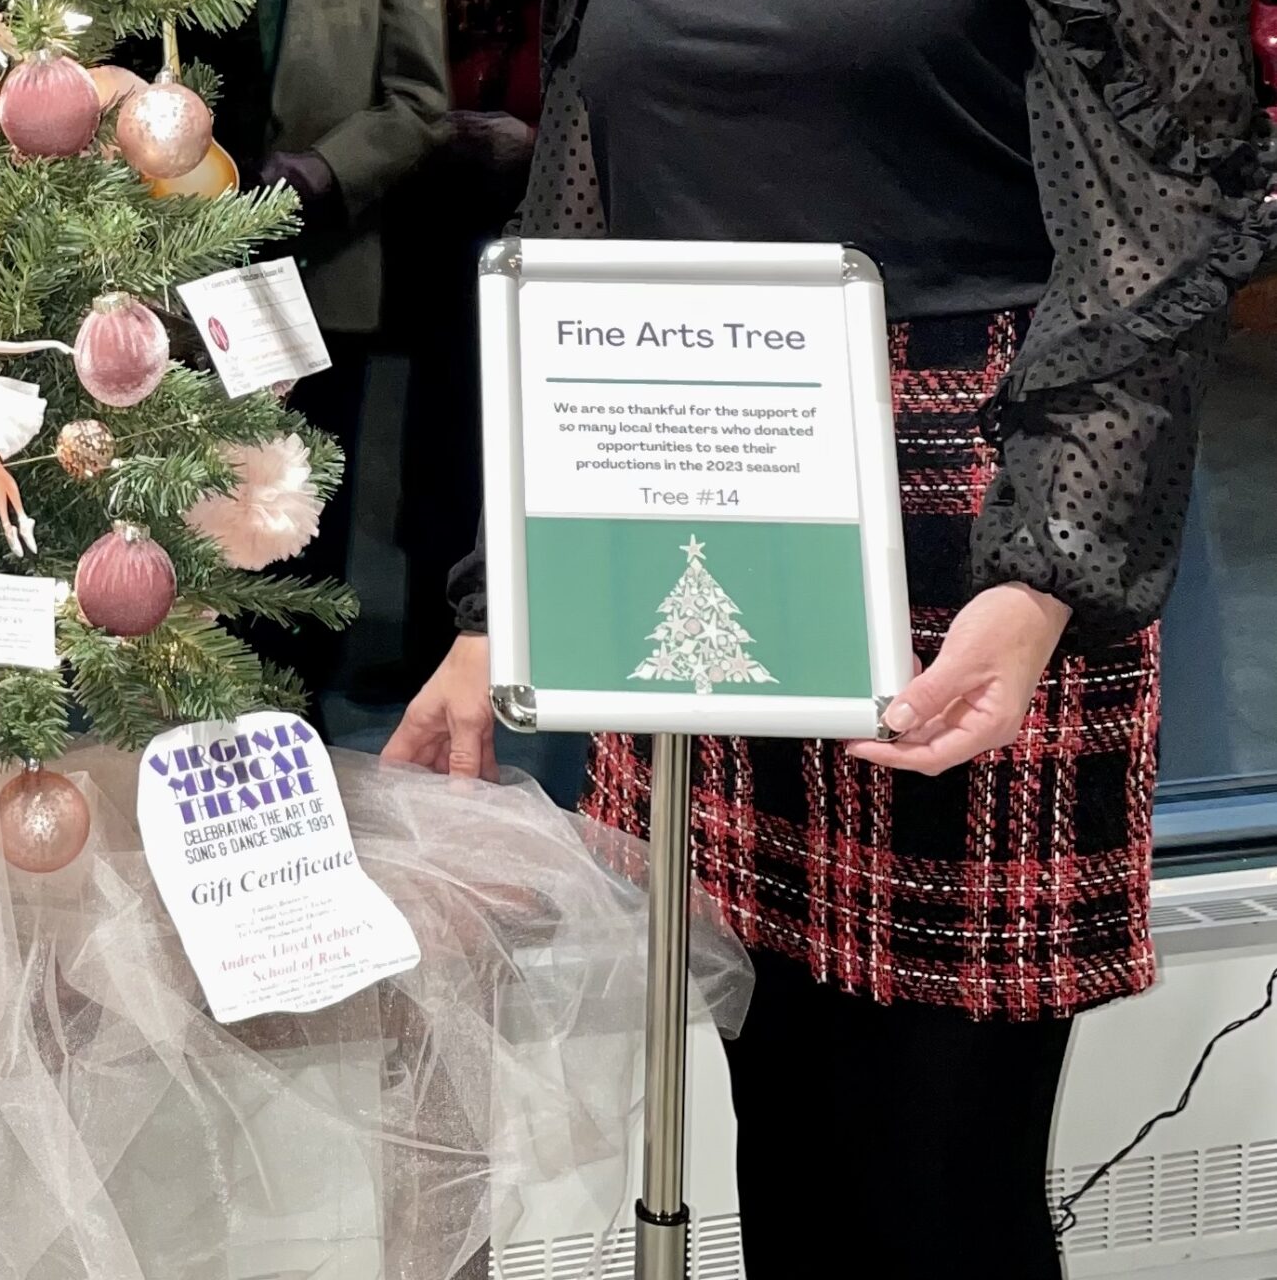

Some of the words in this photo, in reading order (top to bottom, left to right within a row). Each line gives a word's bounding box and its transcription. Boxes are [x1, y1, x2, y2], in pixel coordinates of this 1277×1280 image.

[557, 320, 625, 347] Fine
[635, 321, 714, 348] Arts
[723, 323, 806, 350] Tree
[554, 402, 578, 414] We
[580, 405, 606, 414] are
[608, 405, 625, 415] so
[627, 404, 686, 416] thankful
[689, 405, 711, 416] for
[714, 406, 739, 417] the
[742, 407, 798, 419] support
[801, 407, 817, 418] of
[559, 423, 575, 432] so
[578, 423, 617, 435] many
[619, 422, 652, 433] local
[655, 423, 718, 435] theaters
[721, 424, 751, 435] who
[754, 425, 814, 437] donated
[576, 459, 661, 472] productions
[664, 460, 676, 470] in
[679, 460, 703, 471] the
[706, 460, 743, 472] 2023
[746, 462, 800, 474] season!
[597, 441, 693, 454] opportunities
[696, 442, 712, 453] to
[715, 444, 739, 453] see
[742, 443, 777, 454] their
[639, 488, 689, 505] Tree
[696, 489, 739, 507] #14
[148, 720, 314, 776] VIRGINIA
[167, 746, 313, 800] MUSICAL
[175, 770, 319, 825] THEATRE
[184, 815, 259, 846] CELEBRATING
[259, 808, 284, 826] THE
[285, 802, 307, 819] ART
[309, 797, 325, 814] OF
[185, 844, 216, 865] SONG
[219, 842, 228, 857] &
[232, 832, 268, 853] DANCE
[272, 824, 305, 843] SINCE
[306, 814, 336, 833] 1991
[191, 877, 233, 906] Gift
[240, 850, 354, 893] Certificate
[220, 952, 267, 972] Andrew
[313, 920, 373, 945] Webber's
[253, 960, 297, 983] School
[301, 957, 314, 971] of
[319, 946, 351, 966] Rock
